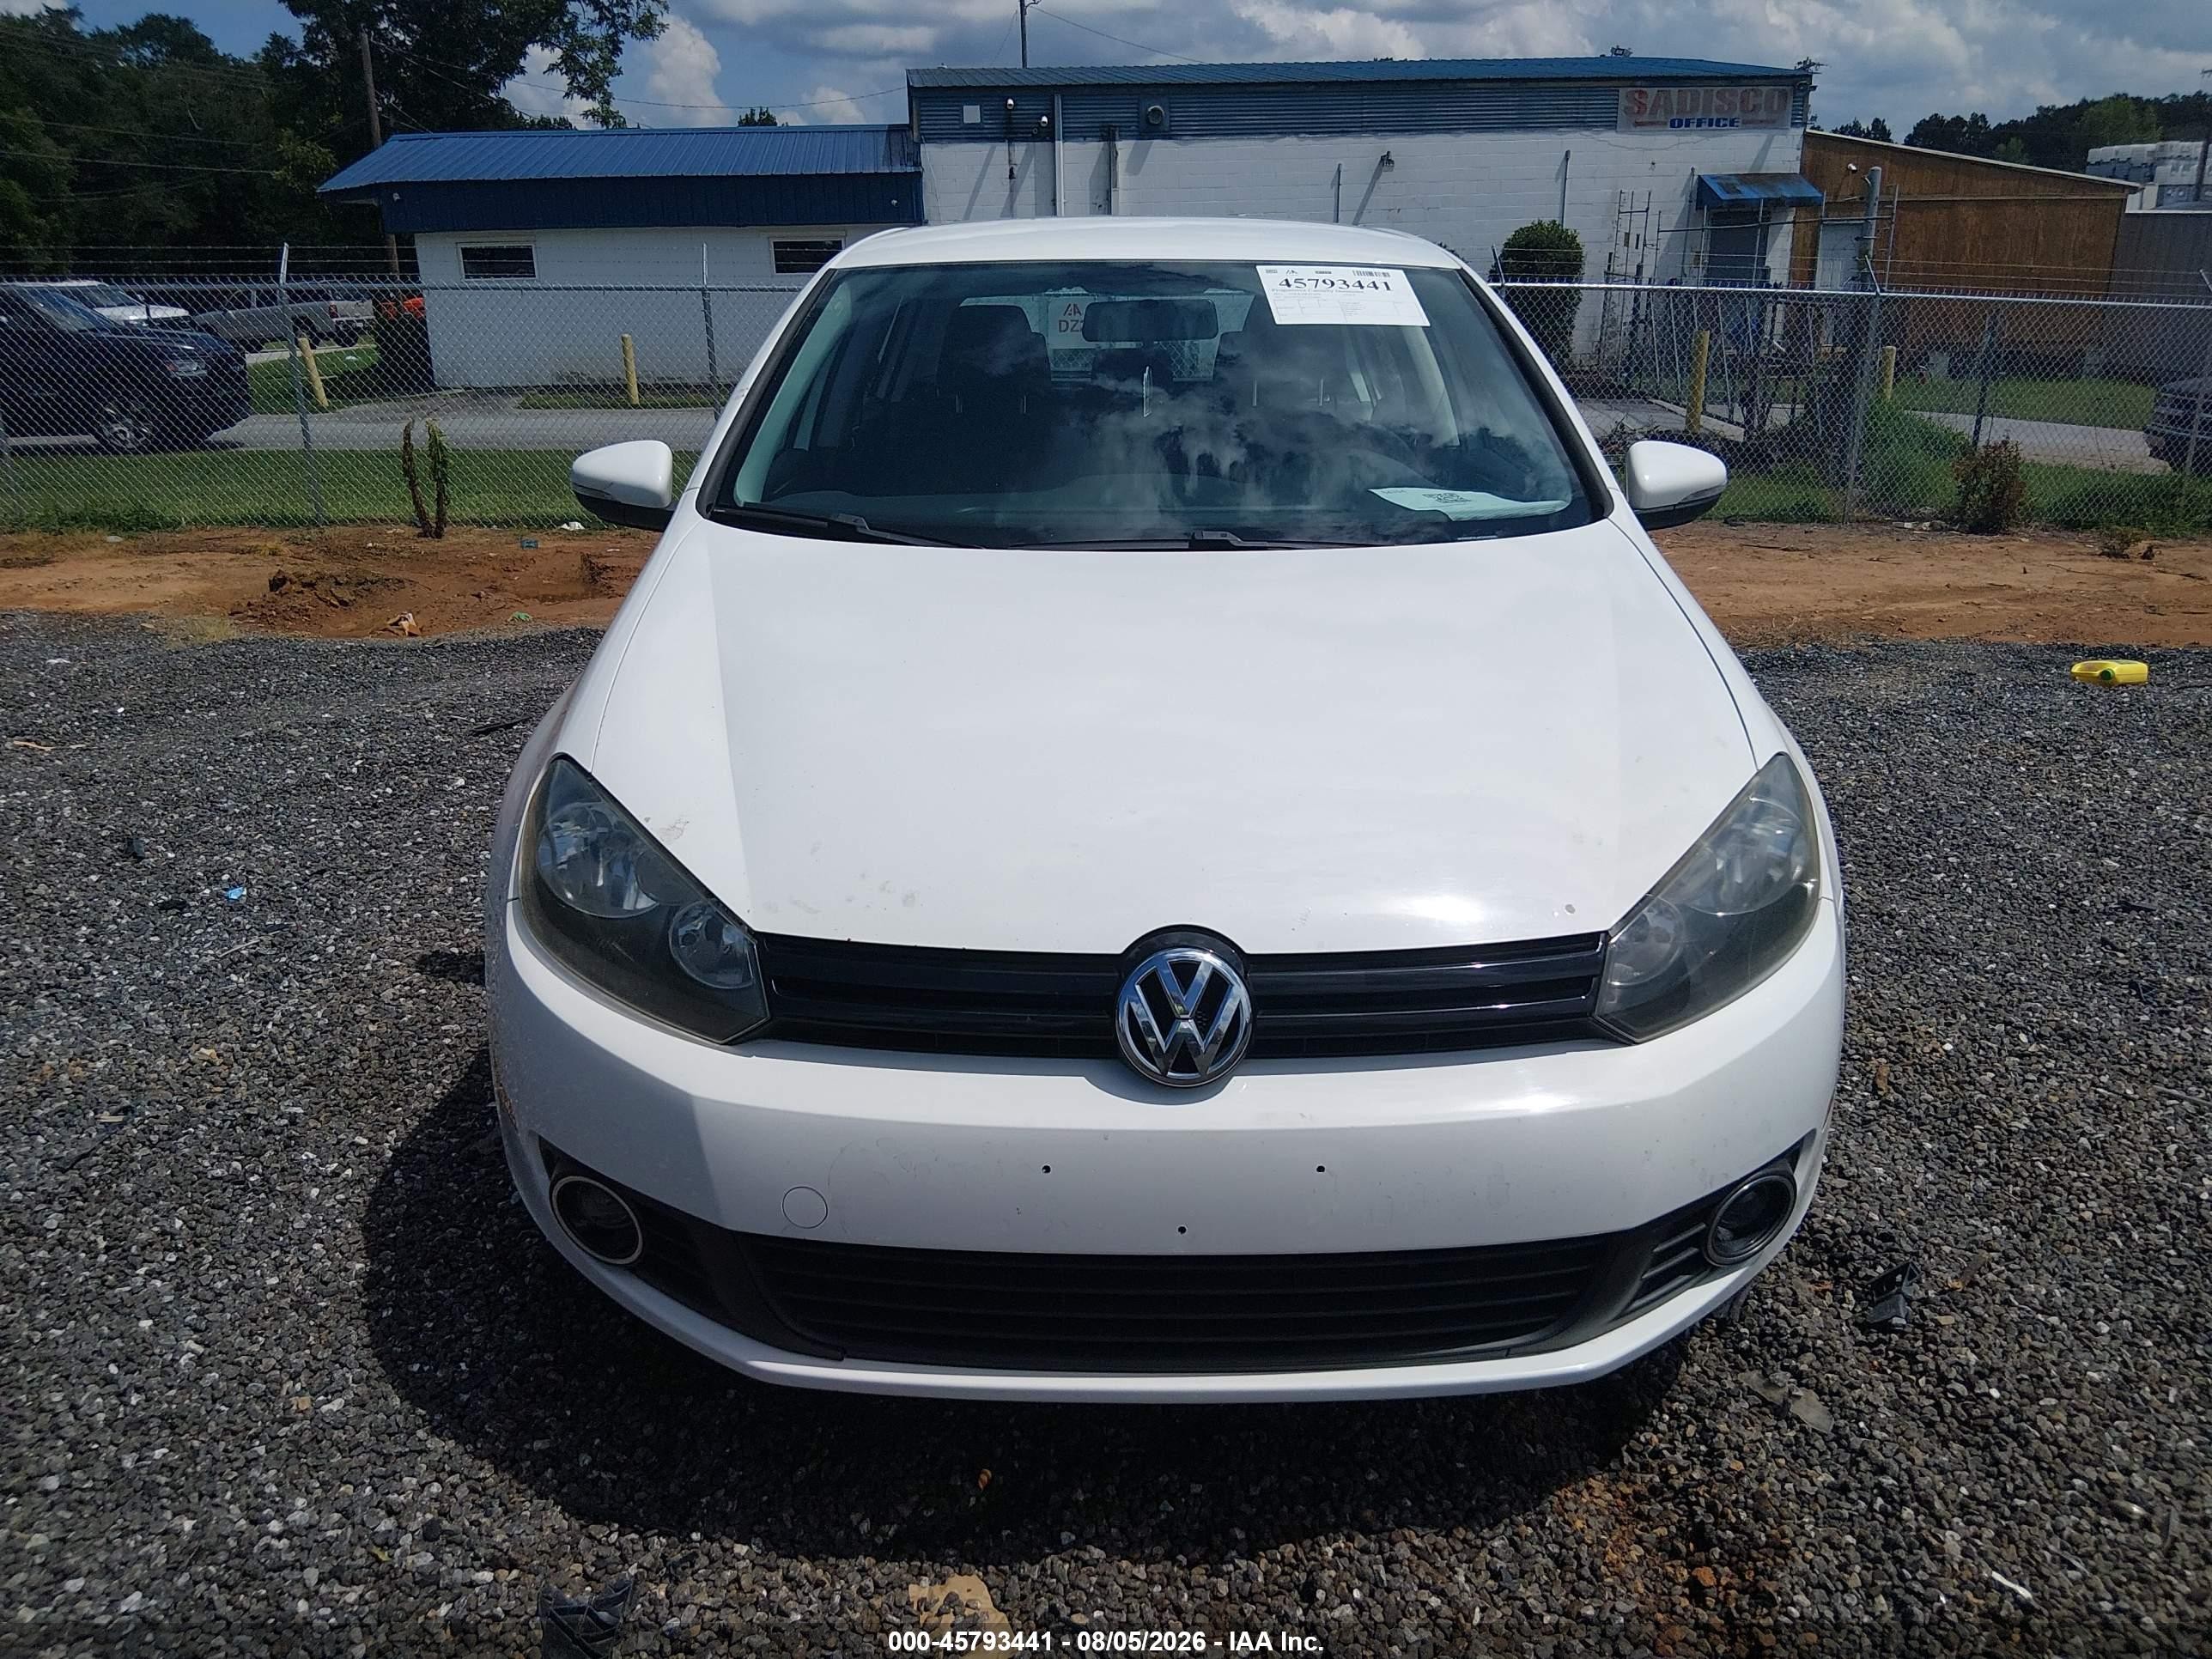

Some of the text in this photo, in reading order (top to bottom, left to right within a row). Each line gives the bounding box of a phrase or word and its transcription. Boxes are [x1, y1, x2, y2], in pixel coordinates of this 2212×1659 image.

[1623, 88, 1789, 116] SADISCO
[1668, 117, 1741, 129] OFFICE
[1279, 277, 1393, 291] 45793441
[1123, 954, 1245, 1080] VW
